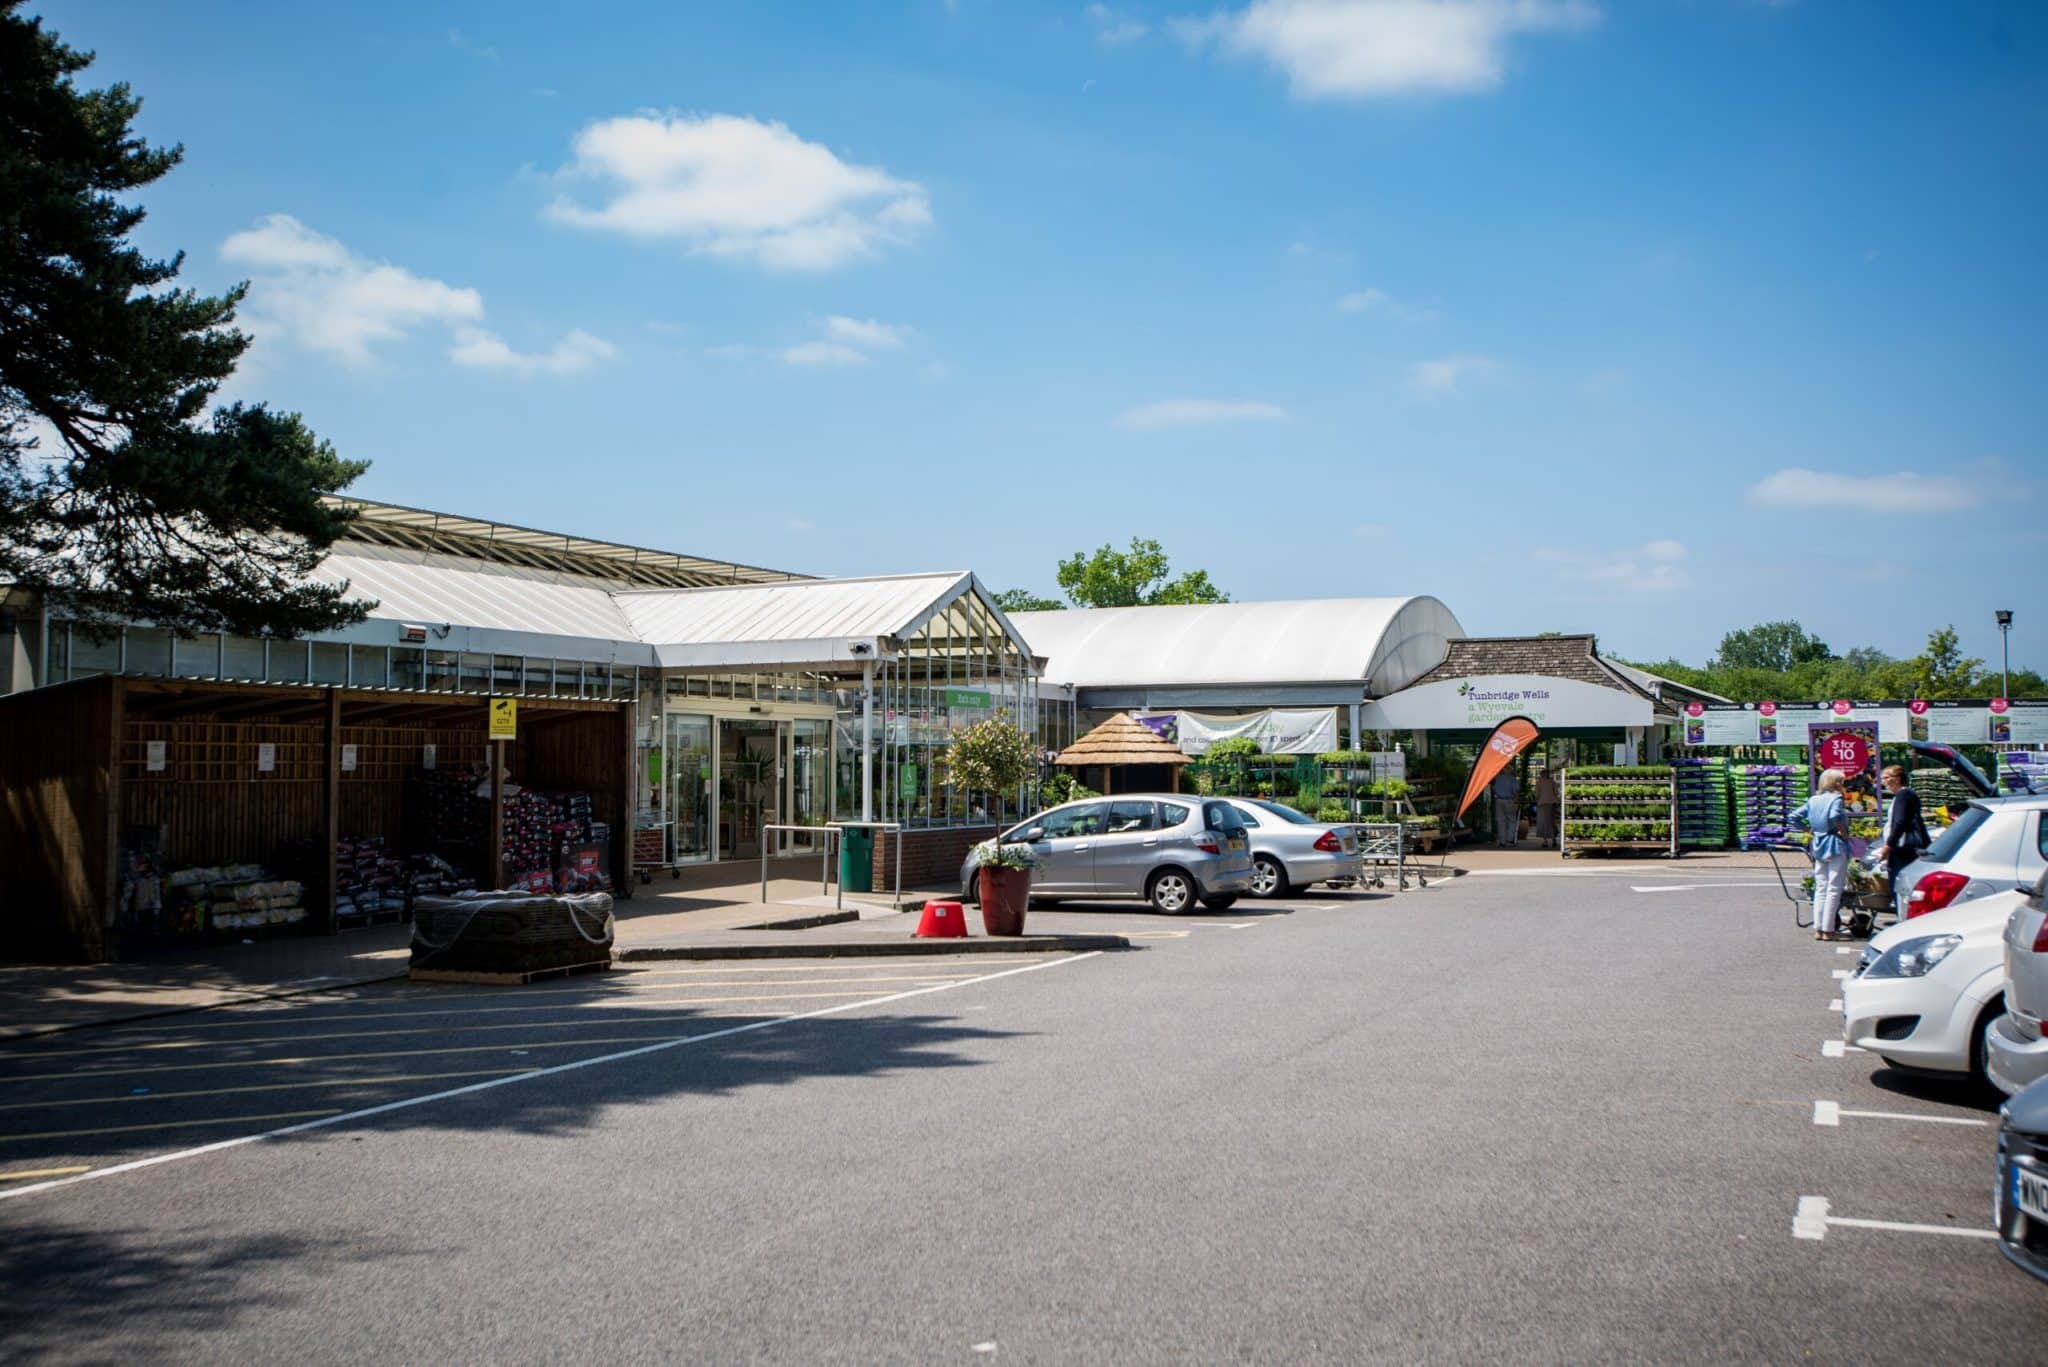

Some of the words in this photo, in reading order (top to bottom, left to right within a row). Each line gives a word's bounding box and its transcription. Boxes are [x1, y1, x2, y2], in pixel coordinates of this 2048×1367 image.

[1467, 691, 1520, 701] Tunbridge
[1522, 690, 1550, 699] Wells
[1832, 740, 1840, 749] 3
[1840, 739, 1856, 749] for
[1833, 748, 1856, 761] £10
